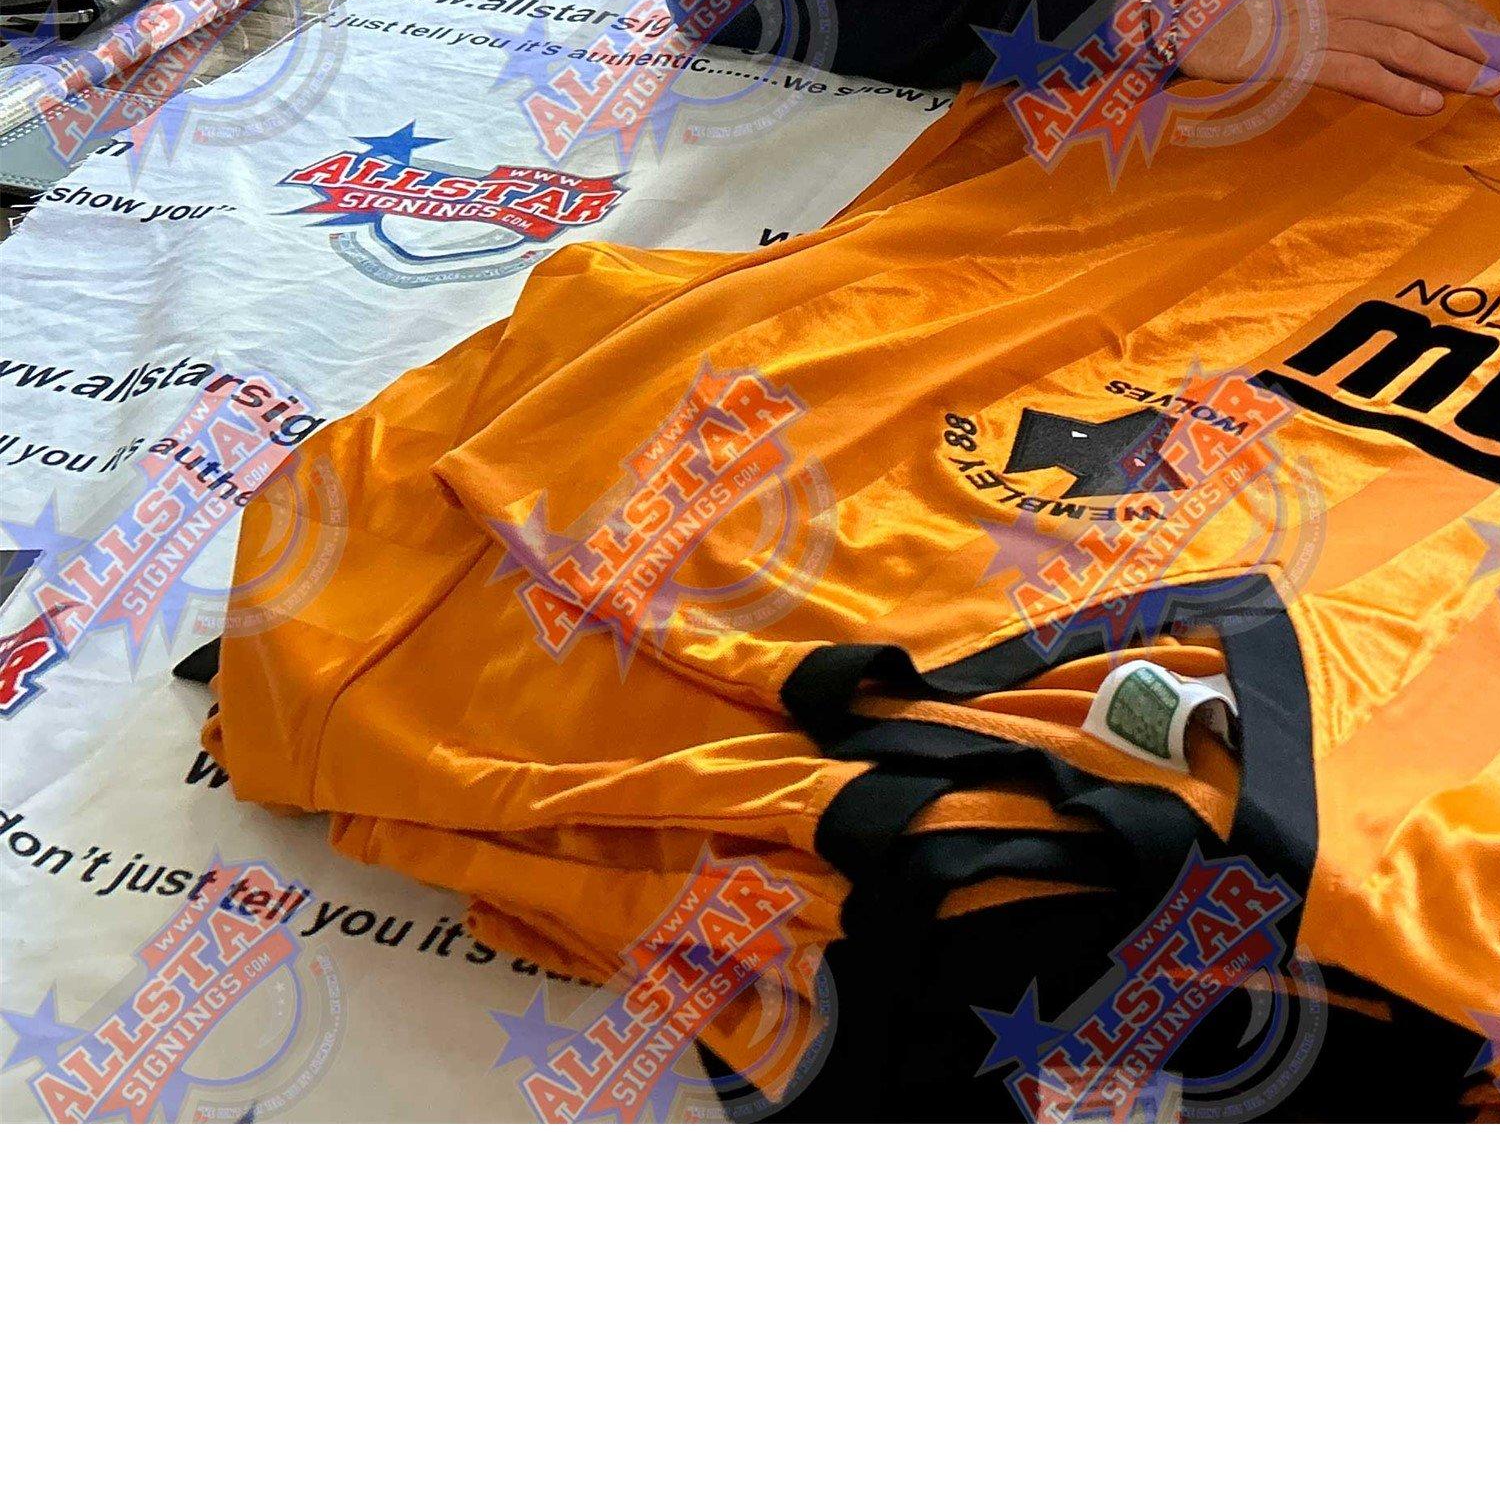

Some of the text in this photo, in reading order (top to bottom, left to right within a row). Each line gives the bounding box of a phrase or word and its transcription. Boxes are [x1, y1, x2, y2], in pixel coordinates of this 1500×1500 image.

[330, 14, 398, 32] just
[400, 23, 453, 40] tell
[447, 29, 510, 49] you
[46, 186, 146, 215] show
[288, 154, 621, 225] ALLSTAR
[338, 192, 499, 219] SIGNINGS
[1104, 379, 1250, 436] WOLVES
[7, 444, 98, 473] you
[944, 412, 1167, 522] WEMBLEY 88
[95, 853, 218, 900] just
[220, 878, 311, 924] tell
[301, 901, 414, 947] you
